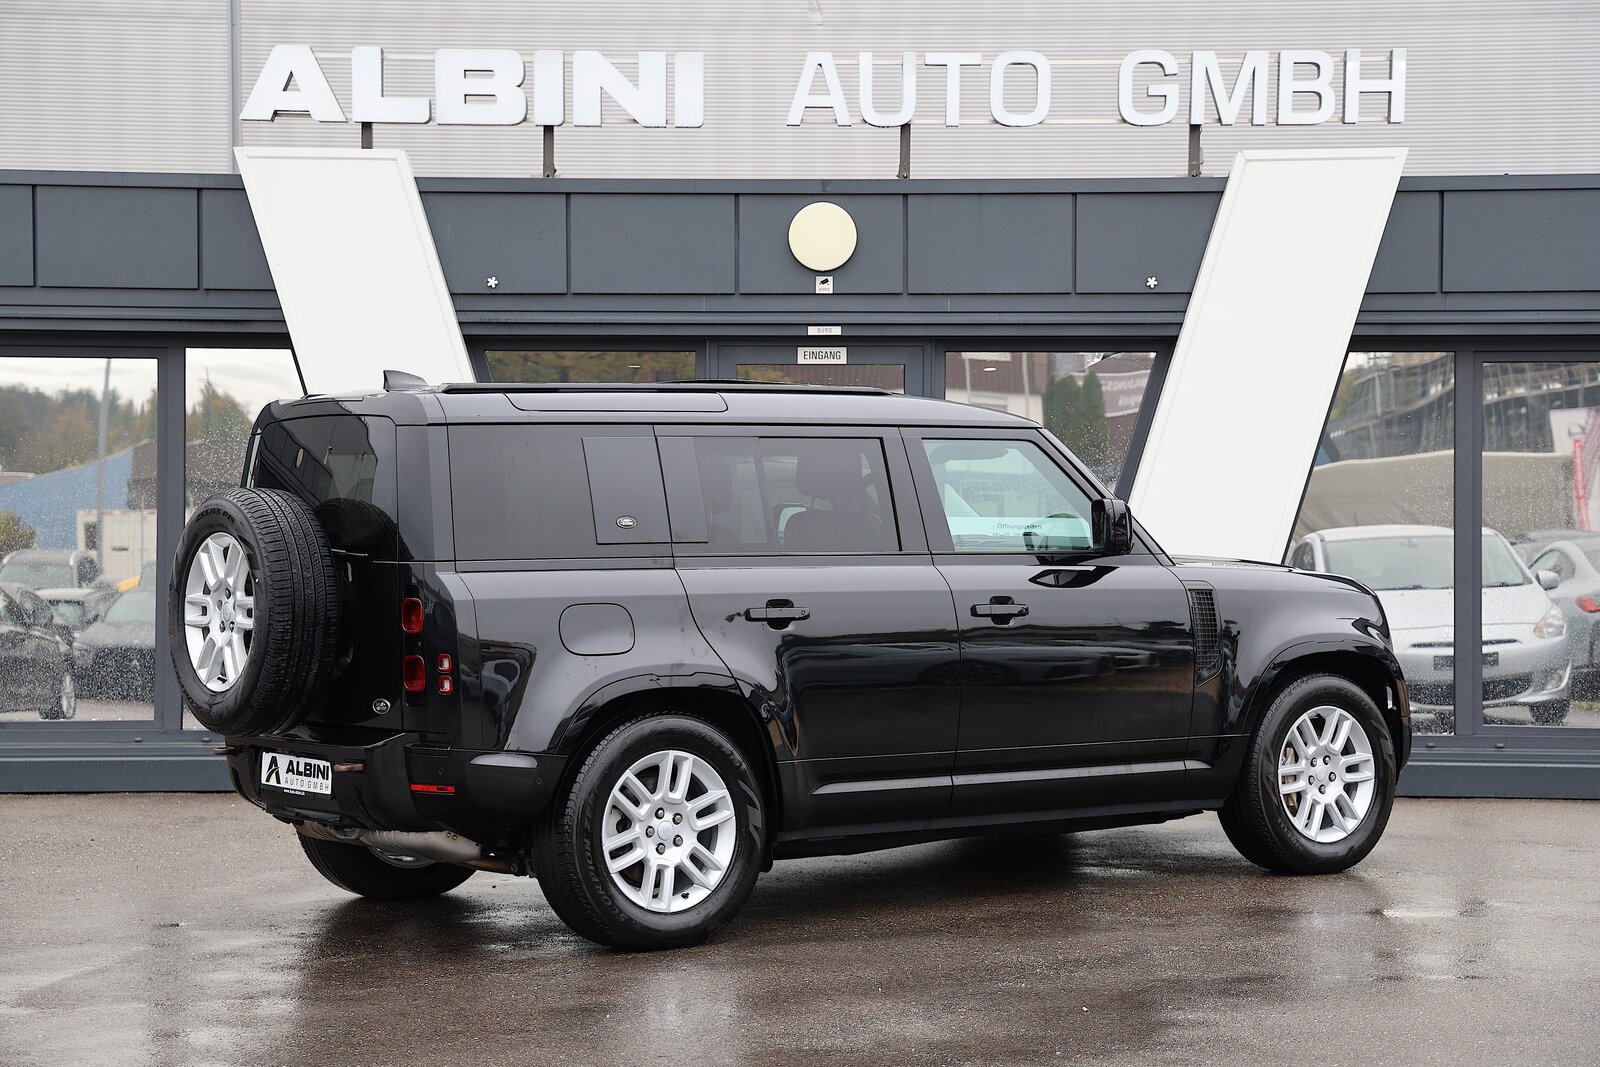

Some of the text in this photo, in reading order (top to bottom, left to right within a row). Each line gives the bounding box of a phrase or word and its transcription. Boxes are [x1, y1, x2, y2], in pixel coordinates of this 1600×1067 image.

[240, 45, 1407, 128] ALBINI AUTO GMBH
[803, 351, 841, 360] EINGANG
[286, 760, 329, 781] ALBINI
[285, 777, 329, 791] AUTO GMBH
[582, 837, 630, 922] SCORPION
